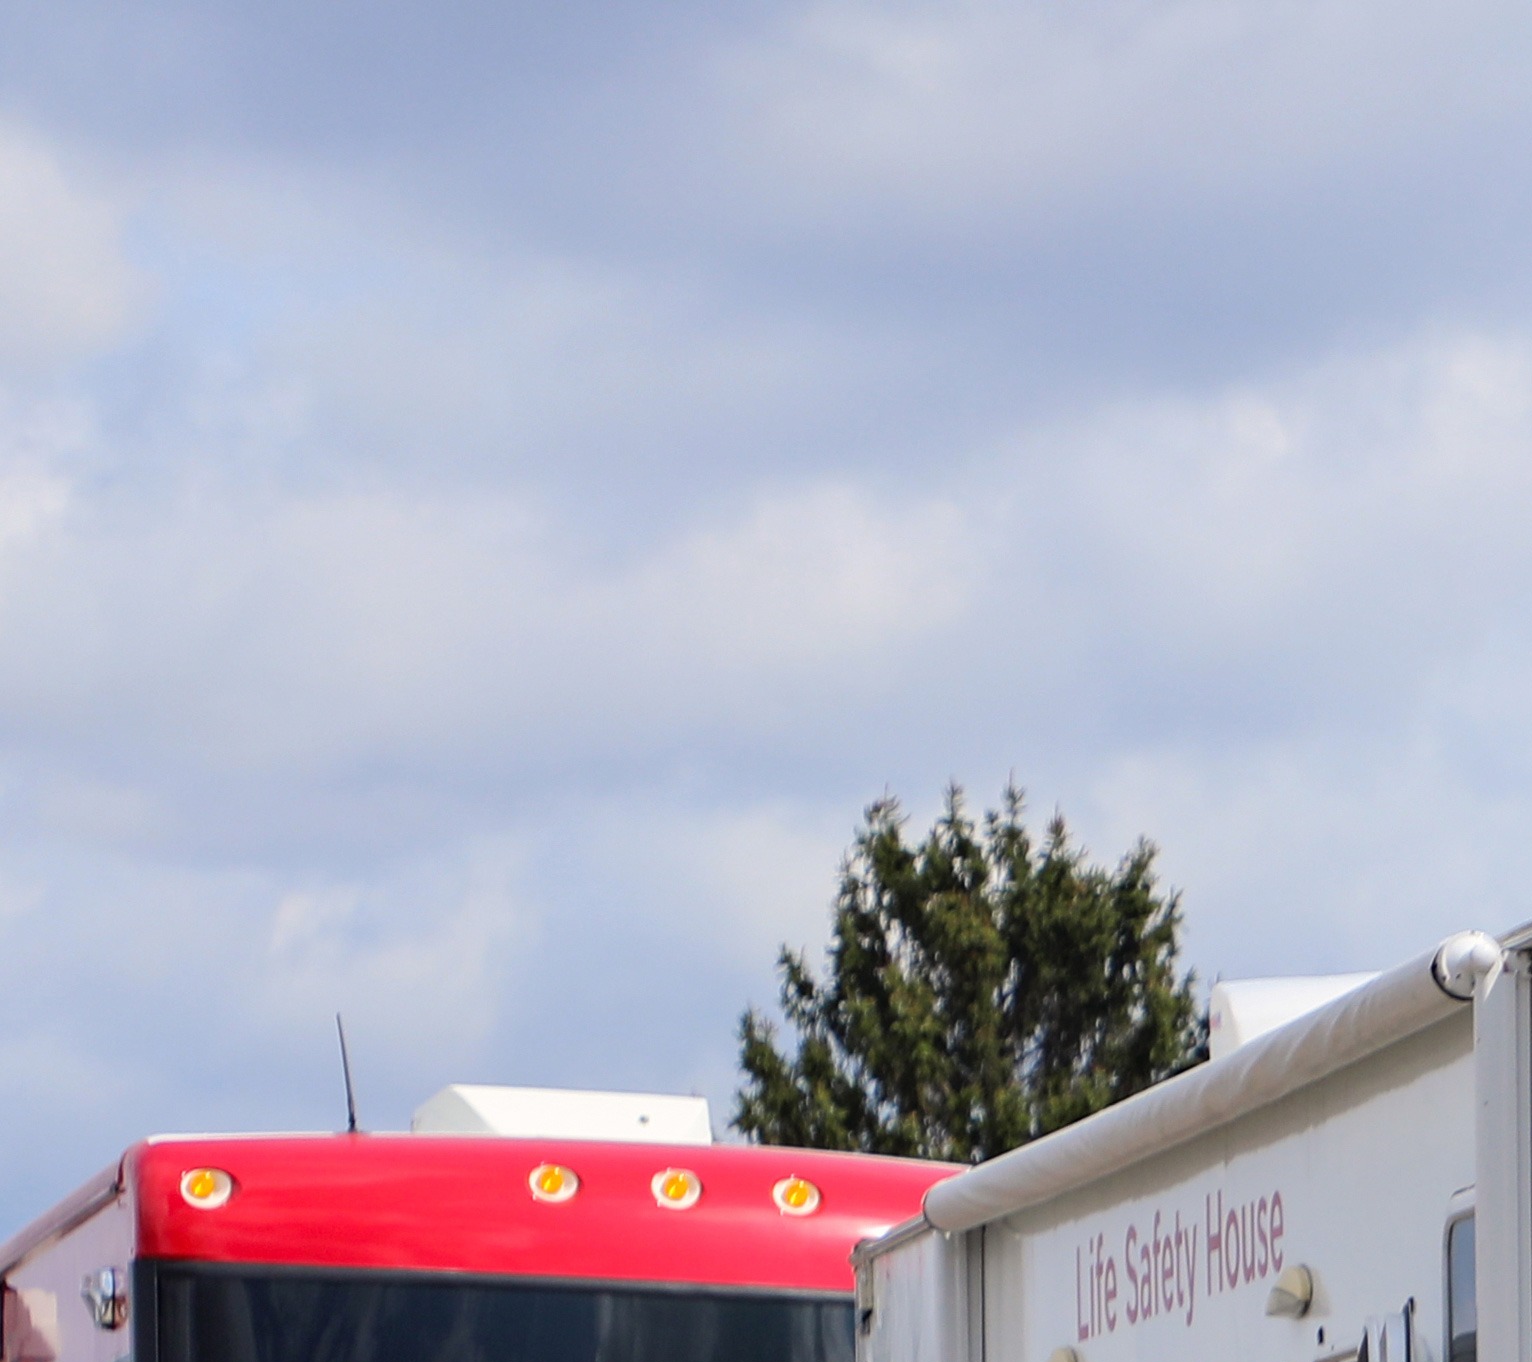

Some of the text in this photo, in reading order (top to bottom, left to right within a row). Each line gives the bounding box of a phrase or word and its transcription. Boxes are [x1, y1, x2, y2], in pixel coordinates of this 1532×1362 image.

[1077, 1189, 1284, 1342] Life Safety House
